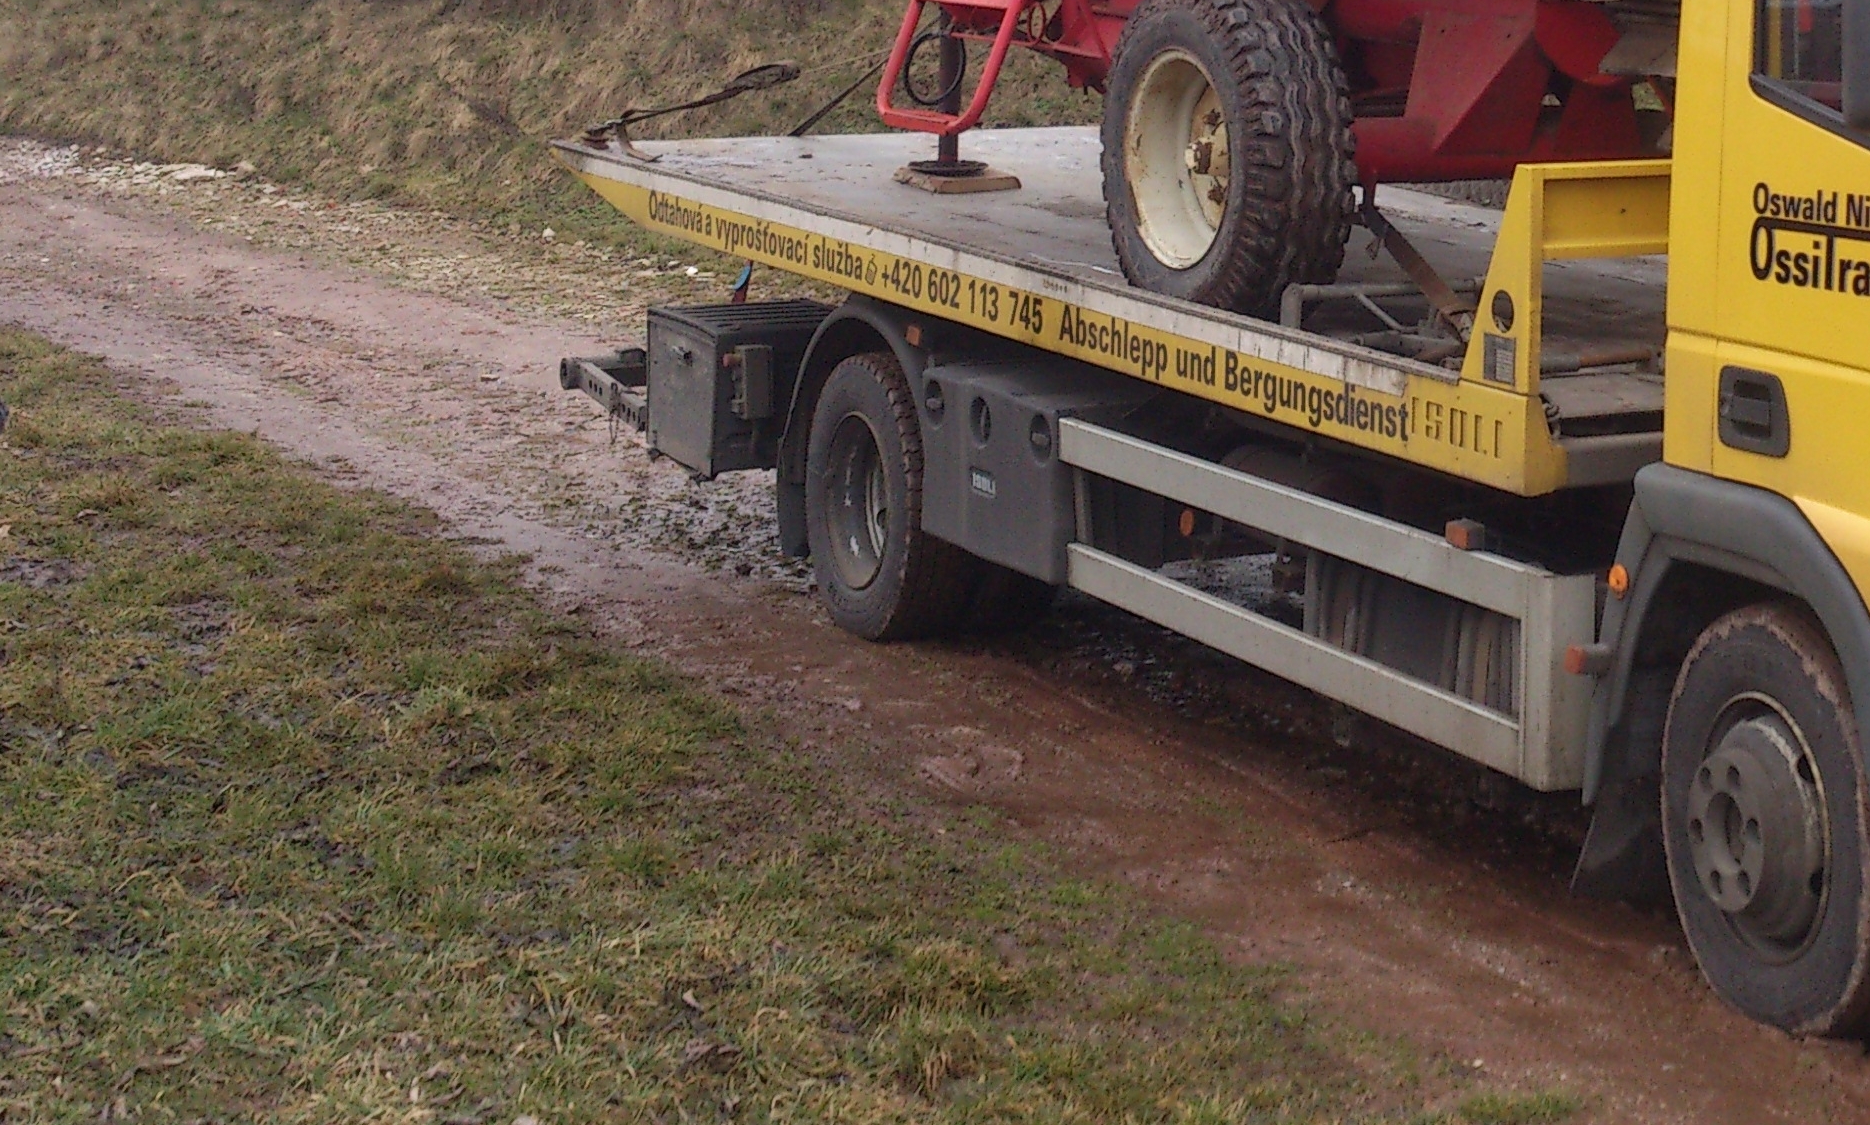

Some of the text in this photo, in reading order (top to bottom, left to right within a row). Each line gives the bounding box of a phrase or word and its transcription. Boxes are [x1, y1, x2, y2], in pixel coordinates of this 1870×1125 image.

[1753, 182, 1837, 224] Oswald
[648, 189, 1410, 442] Odtahová a vyprošťovací služba +420 602 113 745 Abschlepp und Bergungsdienst
